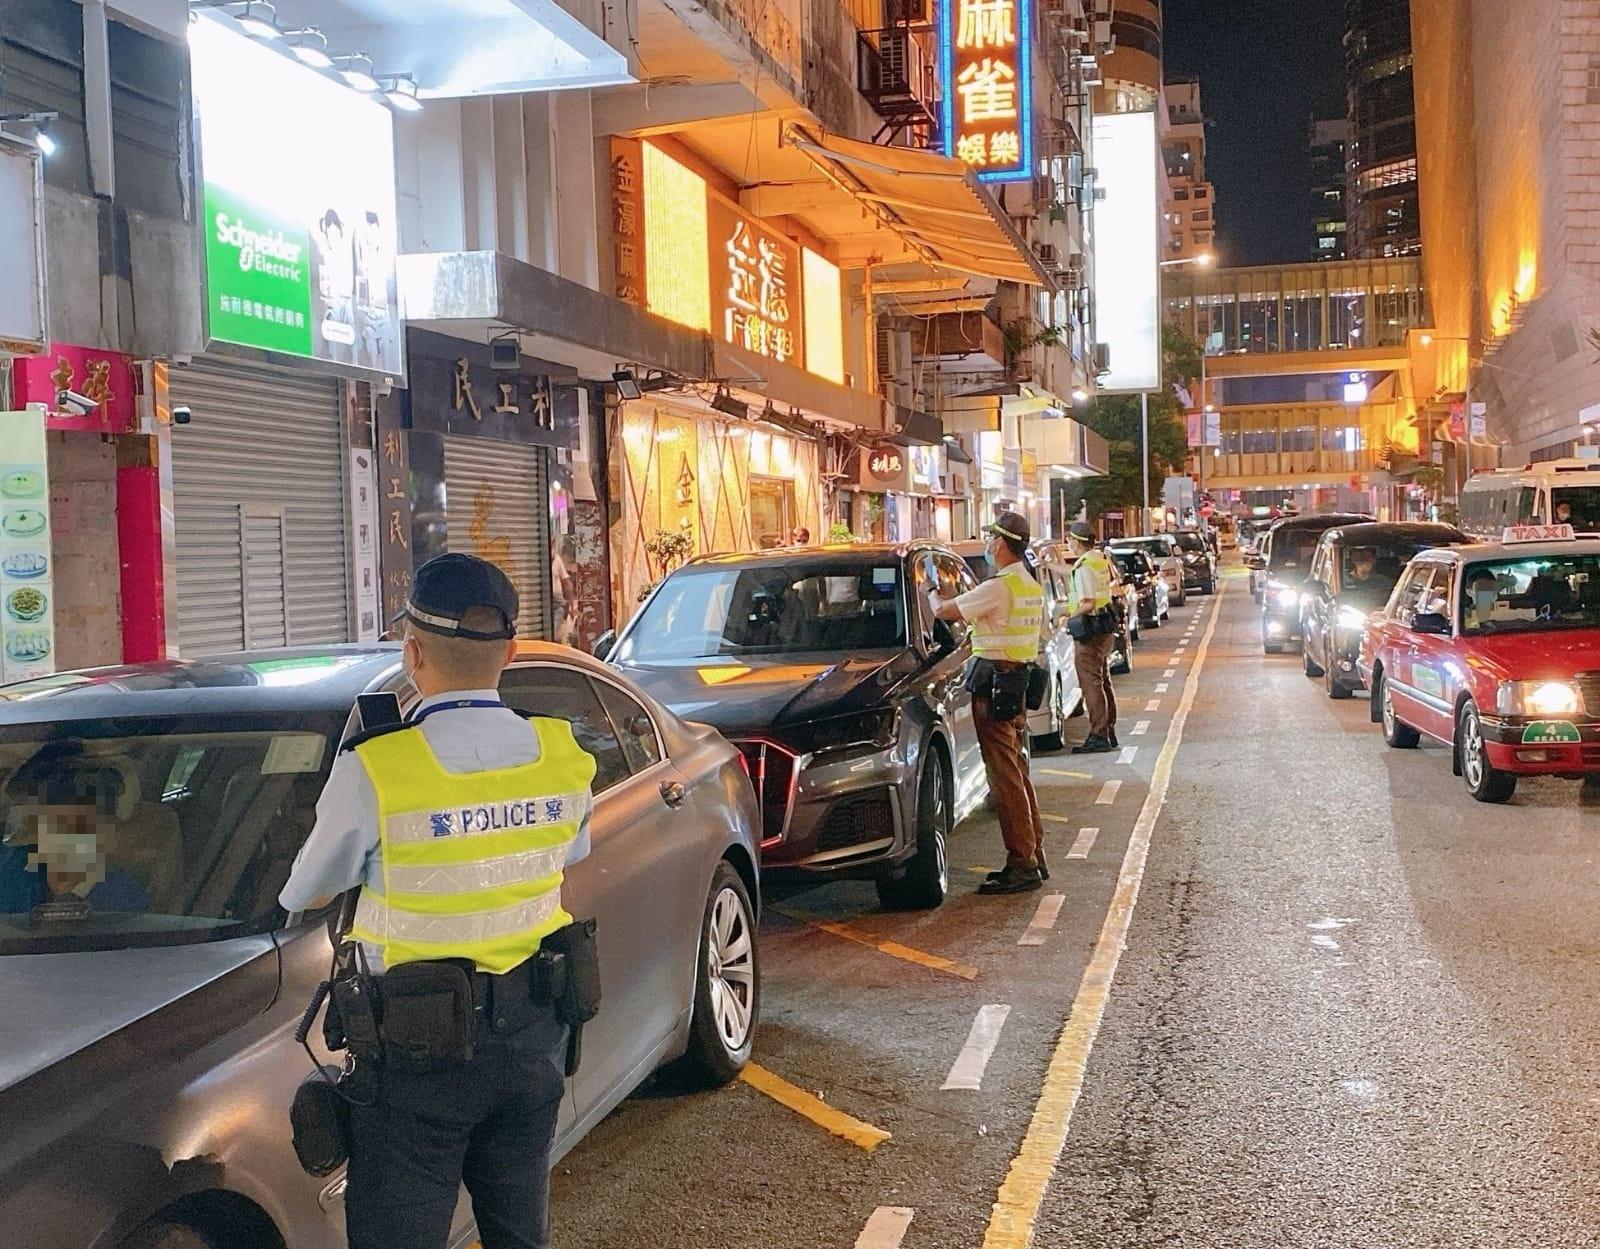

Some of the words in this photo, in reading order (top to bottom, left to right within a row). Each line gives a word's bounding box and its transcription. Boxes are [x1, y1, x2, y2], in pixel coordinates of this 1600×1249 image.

[956, 131, 1019, 166] 娛樂
[215, 211, 302, 265] Schneider
[254, 254, 302, 283] Electric
[383, 428, 408, 550] 利工民
[1511, 525, 1568, 541] TAXI
[1544, 724, 1557, 735] 4
[430, 809, 453, 837] 警
[462, 802, 537, 833] POLICE
[545, 798, 563, 822] 察
